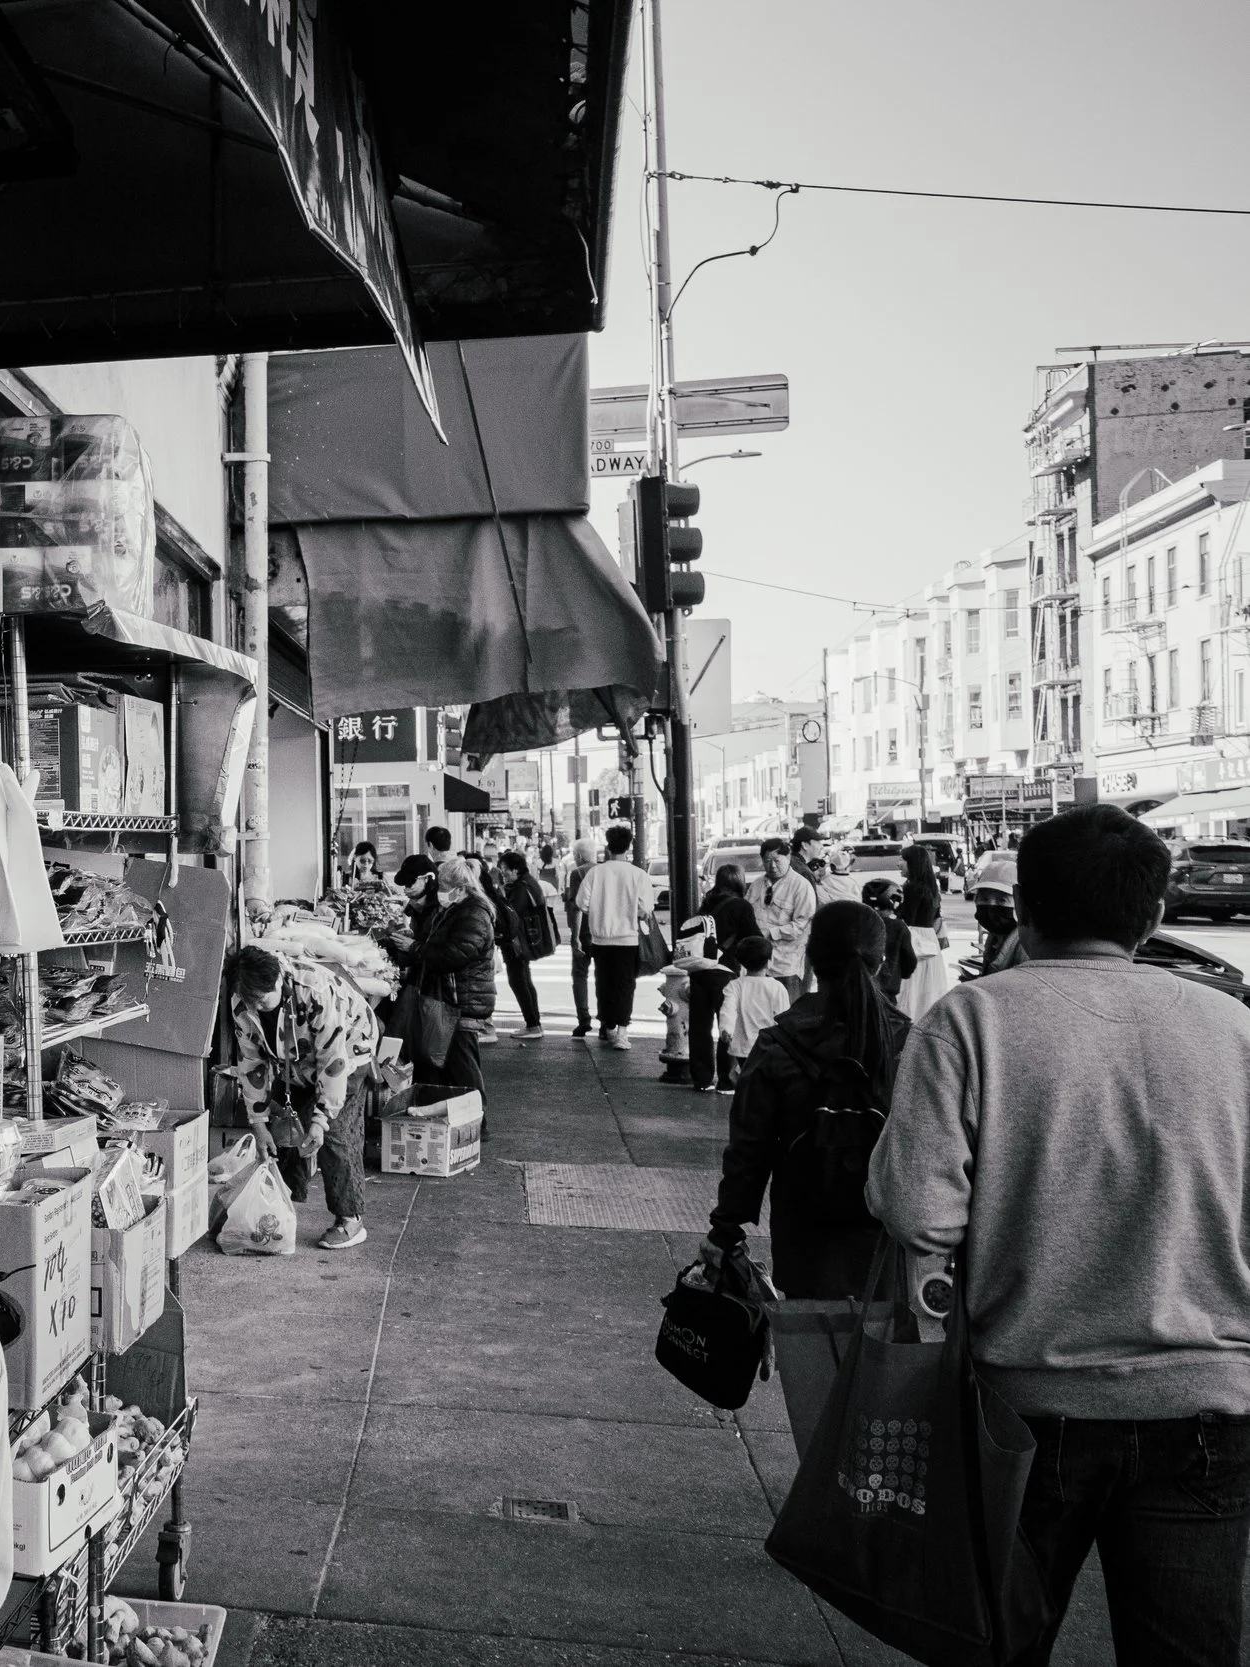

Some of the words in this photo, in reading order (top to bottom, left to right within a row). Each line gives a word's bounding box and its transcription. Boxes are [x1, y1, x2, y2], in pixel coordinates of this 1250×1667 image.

[1, 456, 34, 470] C&S
[590, 456, 645, 472] DWAY
[338, 715, 398, 742] 銀行
[876, 1488, 927, 1516] DOS
